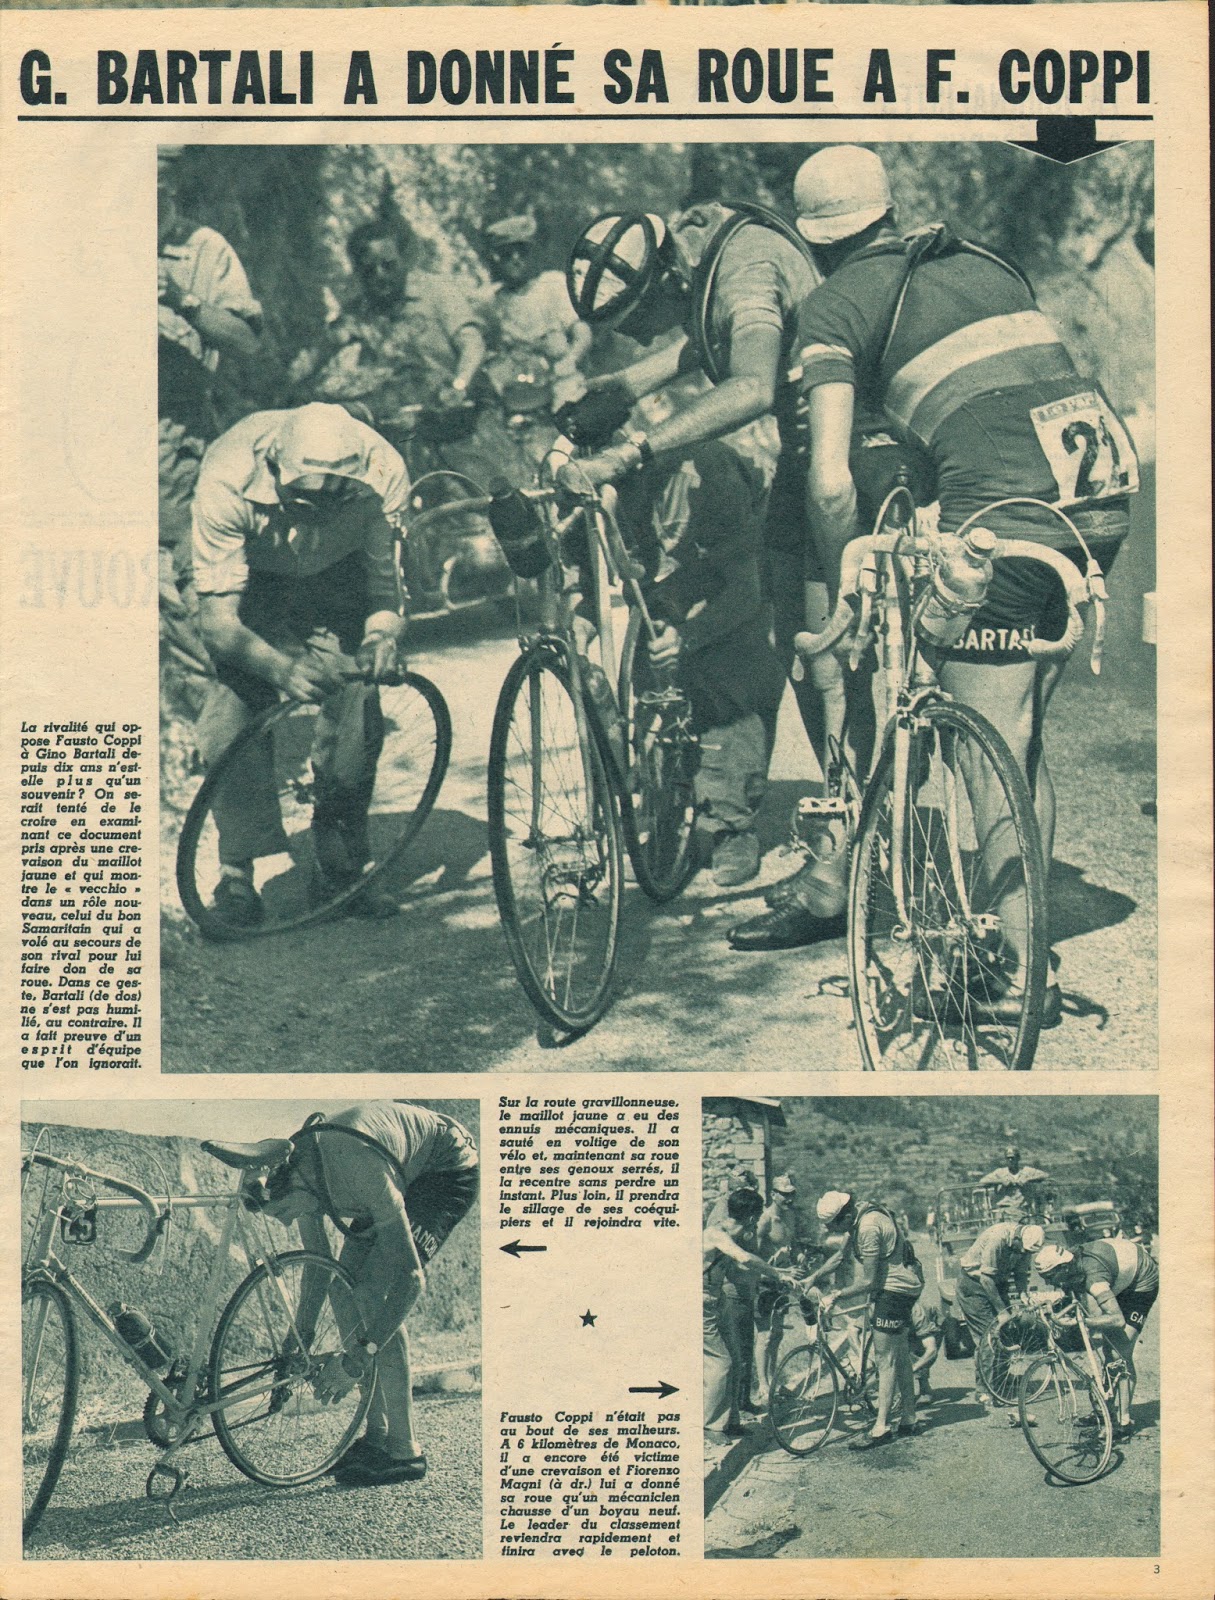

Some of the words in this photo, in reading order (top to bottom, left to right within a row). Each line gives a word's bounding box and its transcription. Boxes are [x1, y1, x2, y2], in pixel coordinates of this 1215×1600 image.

[20, 50, 66, 105] G.
[98, 50, 313, 104] BARTALI
[344, 51, 377, 104] A
[407, 43, 574, 105] DONNÉ
[604, 49, 669, 104] SA
[699, 48, 833, 103] ROUE
[863, 49, 896, 102] A
[927, 50, 969, 103] F.
[999, 49, 1150, 104] COPPI
[21, 722, 37, 732] La
[44, 721, 88, 732] rivalité
[95, 722, 115, 733] qui
[122, 724, 141, 733] op-
[21, 738, 51, 747] pose
[56, 735, 98, 746] Fausto
[104, 734, 141, 747] Coppi
[21, 763, 47, 774] puis
[54, 762, 73, 772] dix
[109, 761, 141, 772] n'est-
[21, 775, 43, 786] elle
[21, 816, 57, 826] croire
[100, 816, 141, 826] exami-
[21, 830, 49, 839] nant
[79, 829, 141, 840] document
[22, 856, 62, 867] vaison
[73, 856, 88, 866] du
[98, 856, 141, 866] maillot
[21, 870, 56, 881] jaune
[65, 871, 76, 880] et
[84, 870, 103, 882] qui
[22, 896, 52, 907] dans
[83, 896, 106, 907] rôle
[22, 913, 56, 921] veau,
[61, 910, 91, 920] celui
[97, 910, 112, 920] du
[118, 910, 141, 921] bon
[22, 923, 91, 933] Samaritain
[103, 924, 123, 935] qui
[21, 953, 42, 961] son
[52, 950, 81, 960] rival
[89, 953, 117, 962] pour
[125, 950, 141, 961] lui
[21, 979, 52, 987] roue.
[58, 976, 90, 987] Dans
[96, 980, 110, 988] ce
[116, 980, 141, 989] ges-
[22, 991, 36, 1000] te,
[42, 990, 84, 1000] Bartali
[90, 990, 109, 1001] (de
[115, 990, 141, 1001] dos)
[20, 1006, 35, 1014] ne
[77, 1007, 99, 1016] pas
[106, 1004, 141, 1014] humi-
[21, 1016, 40, 1027] lié,
[68, 1018, 127, 1027] contraire.
[133, 1017, 141, 1027] Il
[22, 1060, 44, 1070] que
[89, 1058, 141, 1070] ignorait.
[499, 1096, 520, 1107] Sur
[526, 1096, 538, 1107] la
[544, 1098, 576, 1107] route
[582, 1096, 679, 1108] gravillonneuse,
[499, 1124, 540, 1134] ennuis
[555, 1122, 634, 1136] mécaniques.
[648, 1123, 657, 1133] Il
[500, 1149, 526, 1160] vélo
[532, 1151, 547, 1160] et,
[553, 1151, 625, 1160] maintenant
[500, 1164, 531, 1175] entre
[568, 1166, 613, 1175] genoux
[622, 1163, 663, 1174] serrés,
[671, 1163, 679, 1173] il
[500, 1176, 512, 1187] la
[519, 1178, 570, 1187] recentre
[615, 1176, 655, 1189] perdre
[664, 1179, 678, 1187] un
[500, 1190, 545, 1200] instant.
[551, 1190, 577, 1200] Plus
[583, 1190, 610, 1200] loin,
[615, 1190, 624, 1200] il
[629, 1190, 679, 1202] prendra
[500, 1217, 531, 1229] piers
[542, 1218, 553, 1227] et
[565, 1217, 573, 1227] il
[584, 1217, 641, 1229] rejoindra
[654, 1217, 679, 1227] vite.
[500, 1412, 542, 1422] Fausto
[555, 1412, 592, 1424] Coppi
[657, 1414, 680, 1423] pas
[526, 1425, 554, 1435] bout
[564, 1425, 579, 1435] de
[617, 1424, 680, 1435] malheurs.
[500, 1439, 510, 1449] A
[518, 1439, 524, 1449] 6
[531, 1438, 597, 1449] kilomètres
[604, 1438, 618, 1448] de
[626, 1438, 680, 1448] Monaco,
[541, 1466, 601, 1476] crevaison
[609, 1466, 620, 1475] et
[626, 1465, 680, 1475] Fiorenzo
[608, 1491, 680, 1502] mécanicien
[500, 1506, 551, 1516] chausse
[599, 1505, 639, 1518] boyau
[649, 1505, 680, 1516] neuf.
[500, 1519, 515, 1529] Le
[528, 1519, 568, 1530] leader
[581, 1519, 597, 1529] du
[610, 1519, 680, 1529] classement
[500, 1532, 561, 1543] reviendra
[579, 1532, 651, 1544] rapidement
[669, 1533, 680, 1542] et
[502, 1546, 535, 1556] finira
[601, 1545, 612, 1555] le
[630, 1545, 680, 1557] peloton.
[1153, 1564, 1161, 1575] 3
